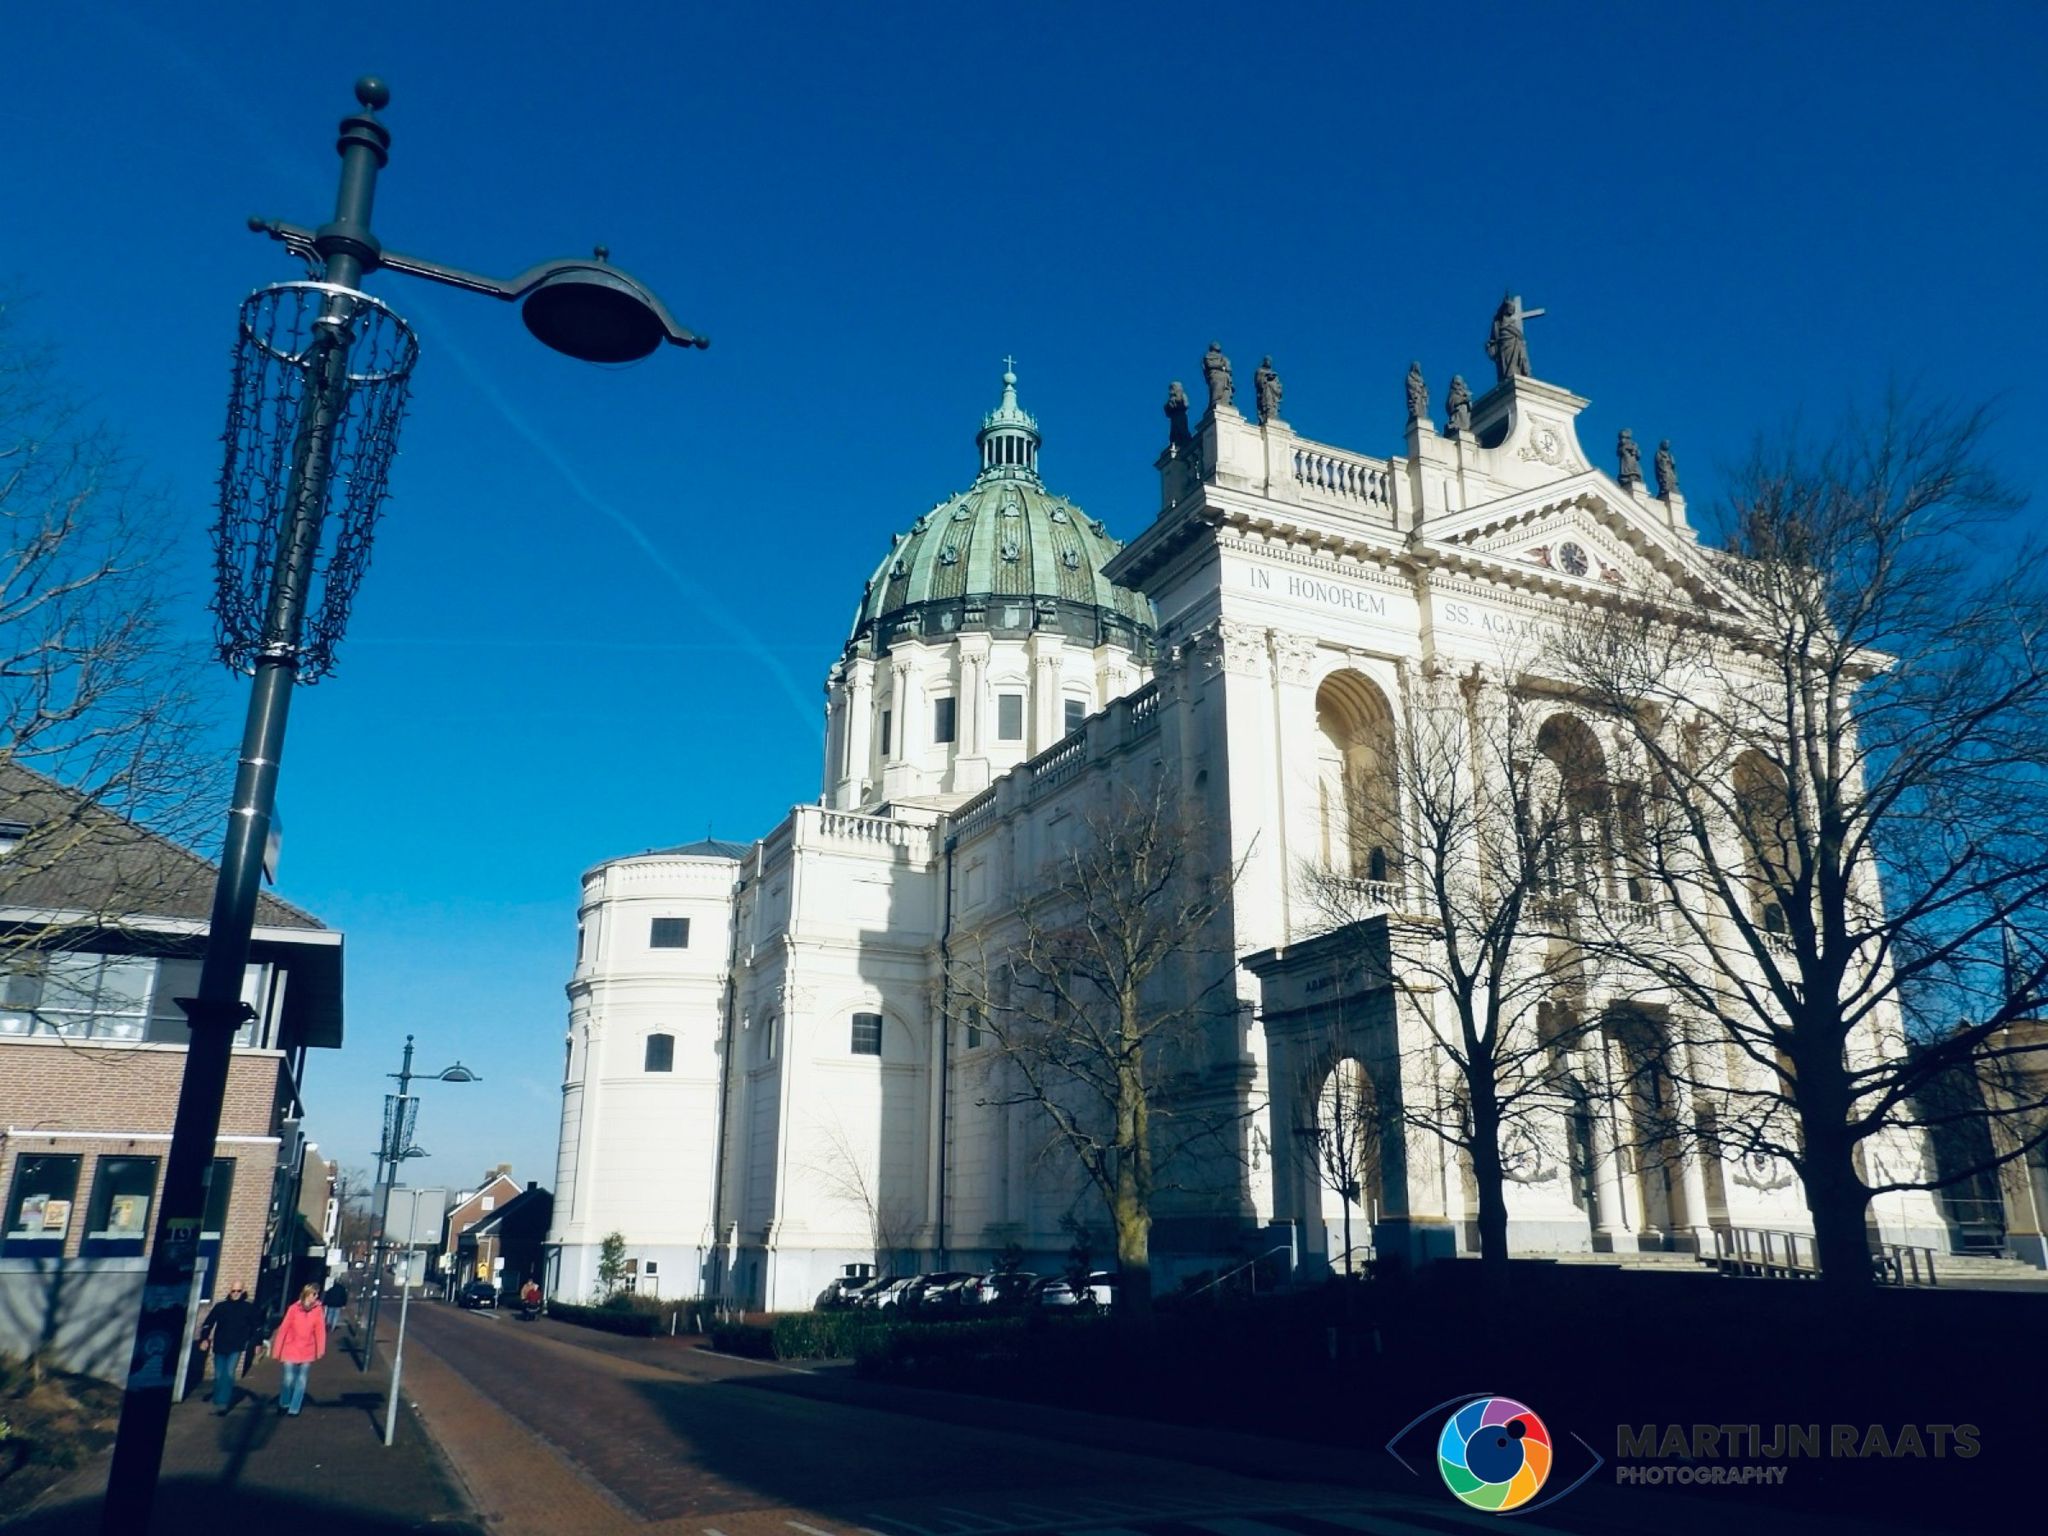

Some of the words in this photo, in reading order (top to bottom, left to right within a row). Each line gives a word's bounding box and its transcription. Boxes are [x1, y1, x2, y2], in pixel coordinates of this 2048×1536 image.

[1249, 567, 1270, 590] IN
[1287, 575, 1386, 616] HONOREM
[1444, 603, 1475, 626] SS.
